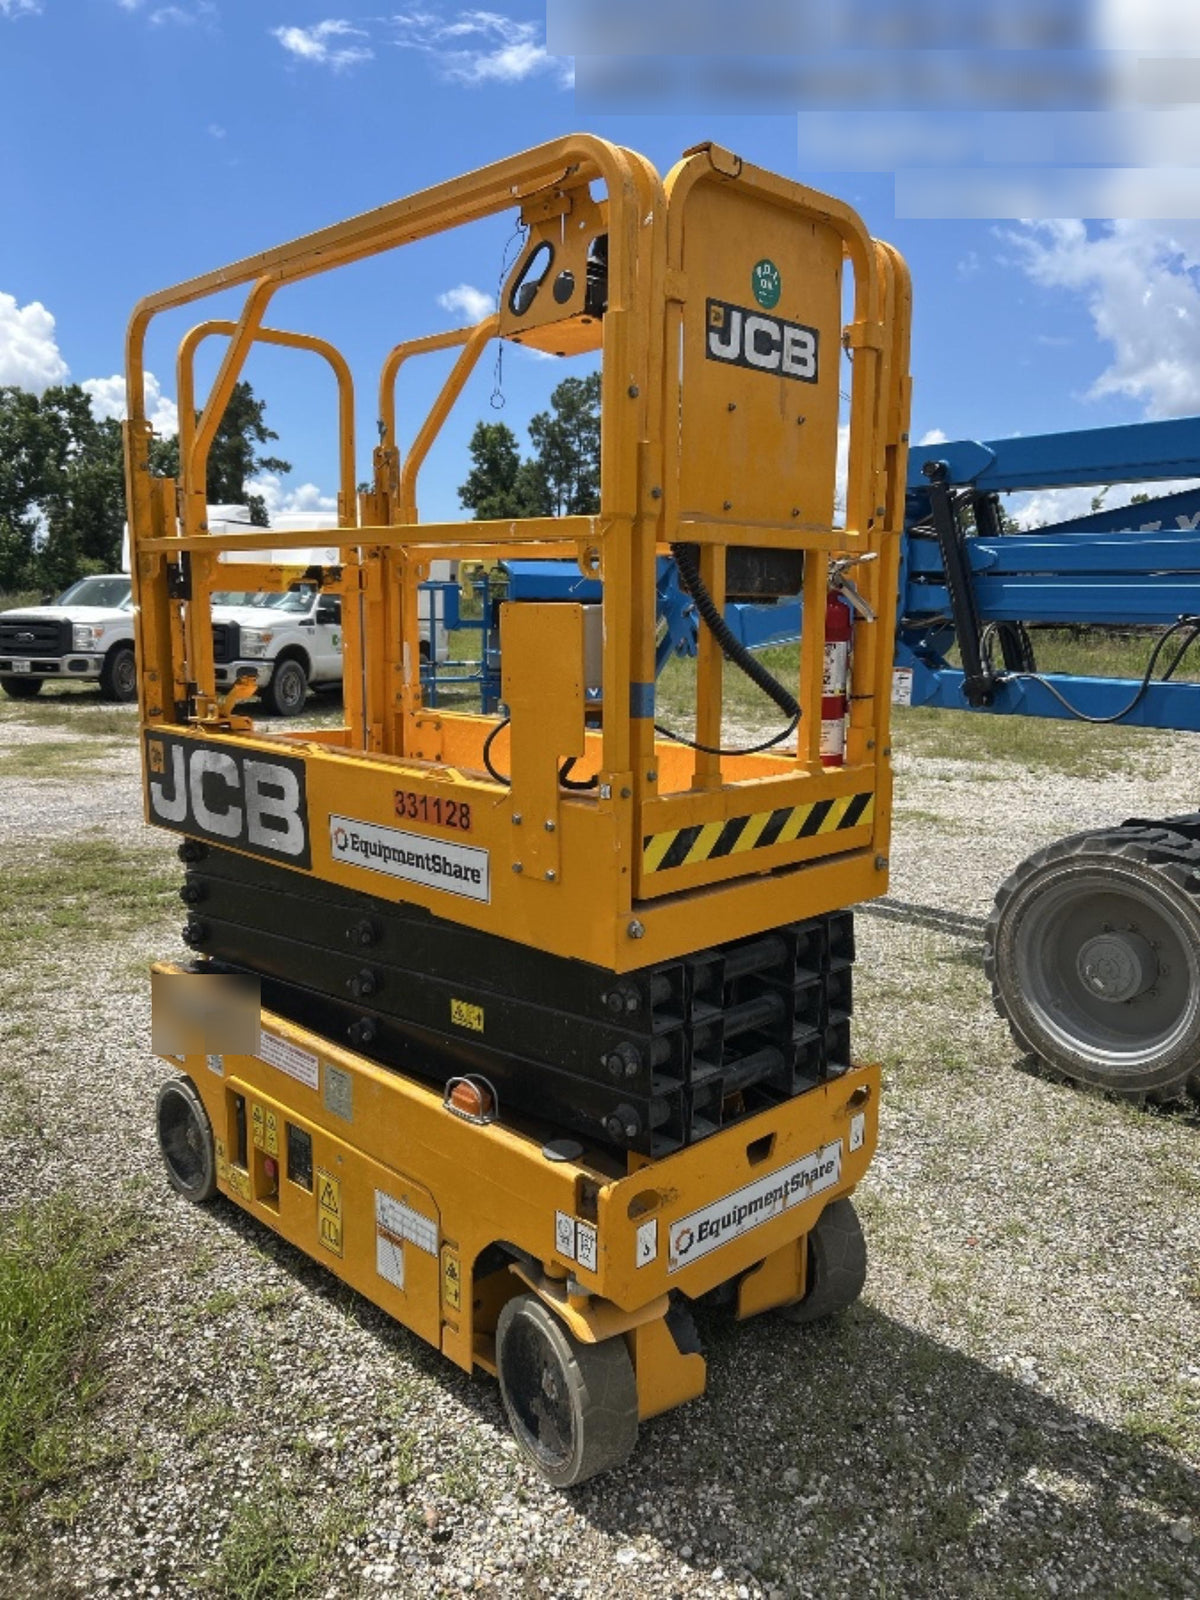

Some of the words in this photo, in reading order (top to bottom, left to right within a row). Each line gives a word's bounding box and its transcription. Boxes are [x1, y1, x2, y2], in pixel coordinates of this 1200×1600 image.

[709, 311, 816, 378] JCB
[150, 744, 305, 856] JCB
[394, 790, 471, 831] 331128
[350, 832, 481, 884] EquipmentShare
[696, 1160, 835, 1244] EquipmentShare
